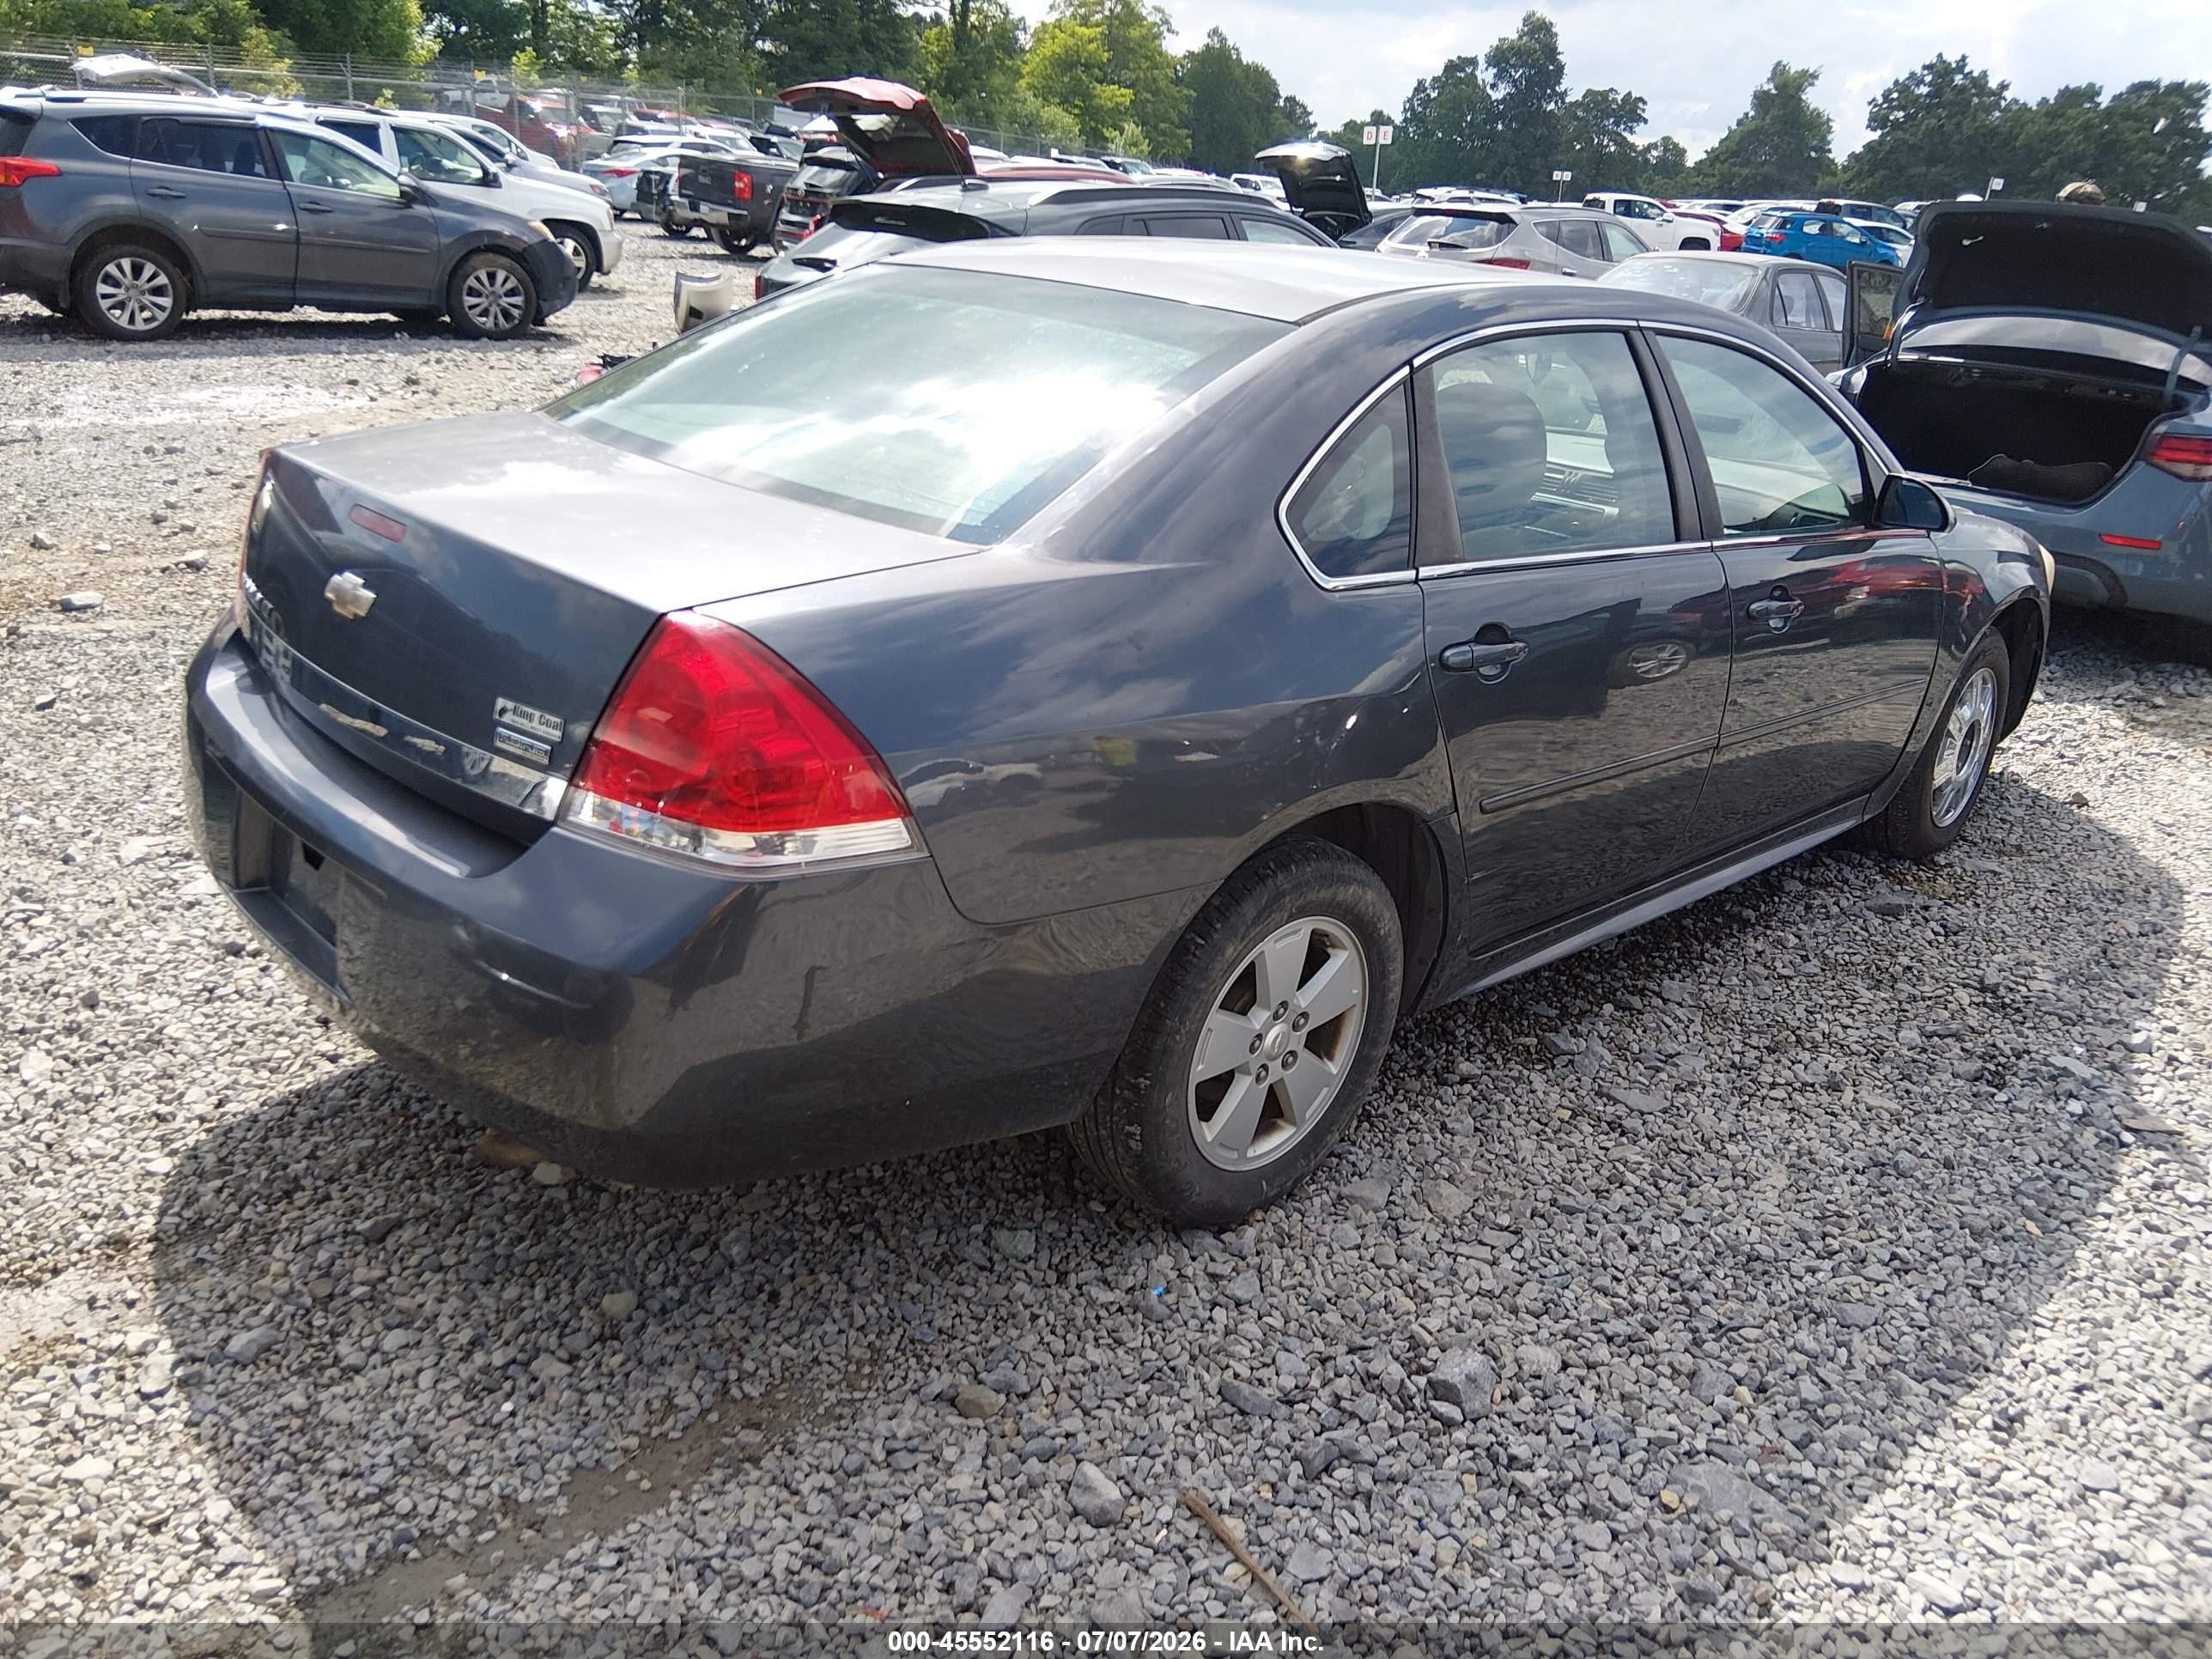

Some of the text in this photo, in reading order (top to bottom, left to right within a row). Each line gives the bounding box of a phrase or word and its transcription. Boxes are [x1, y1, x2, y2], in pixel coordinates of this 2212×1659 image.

[1367, 131, 1373, 140] D
[1382, 131, 1389, 140] E
[538, 714, 563, 732] Coal
